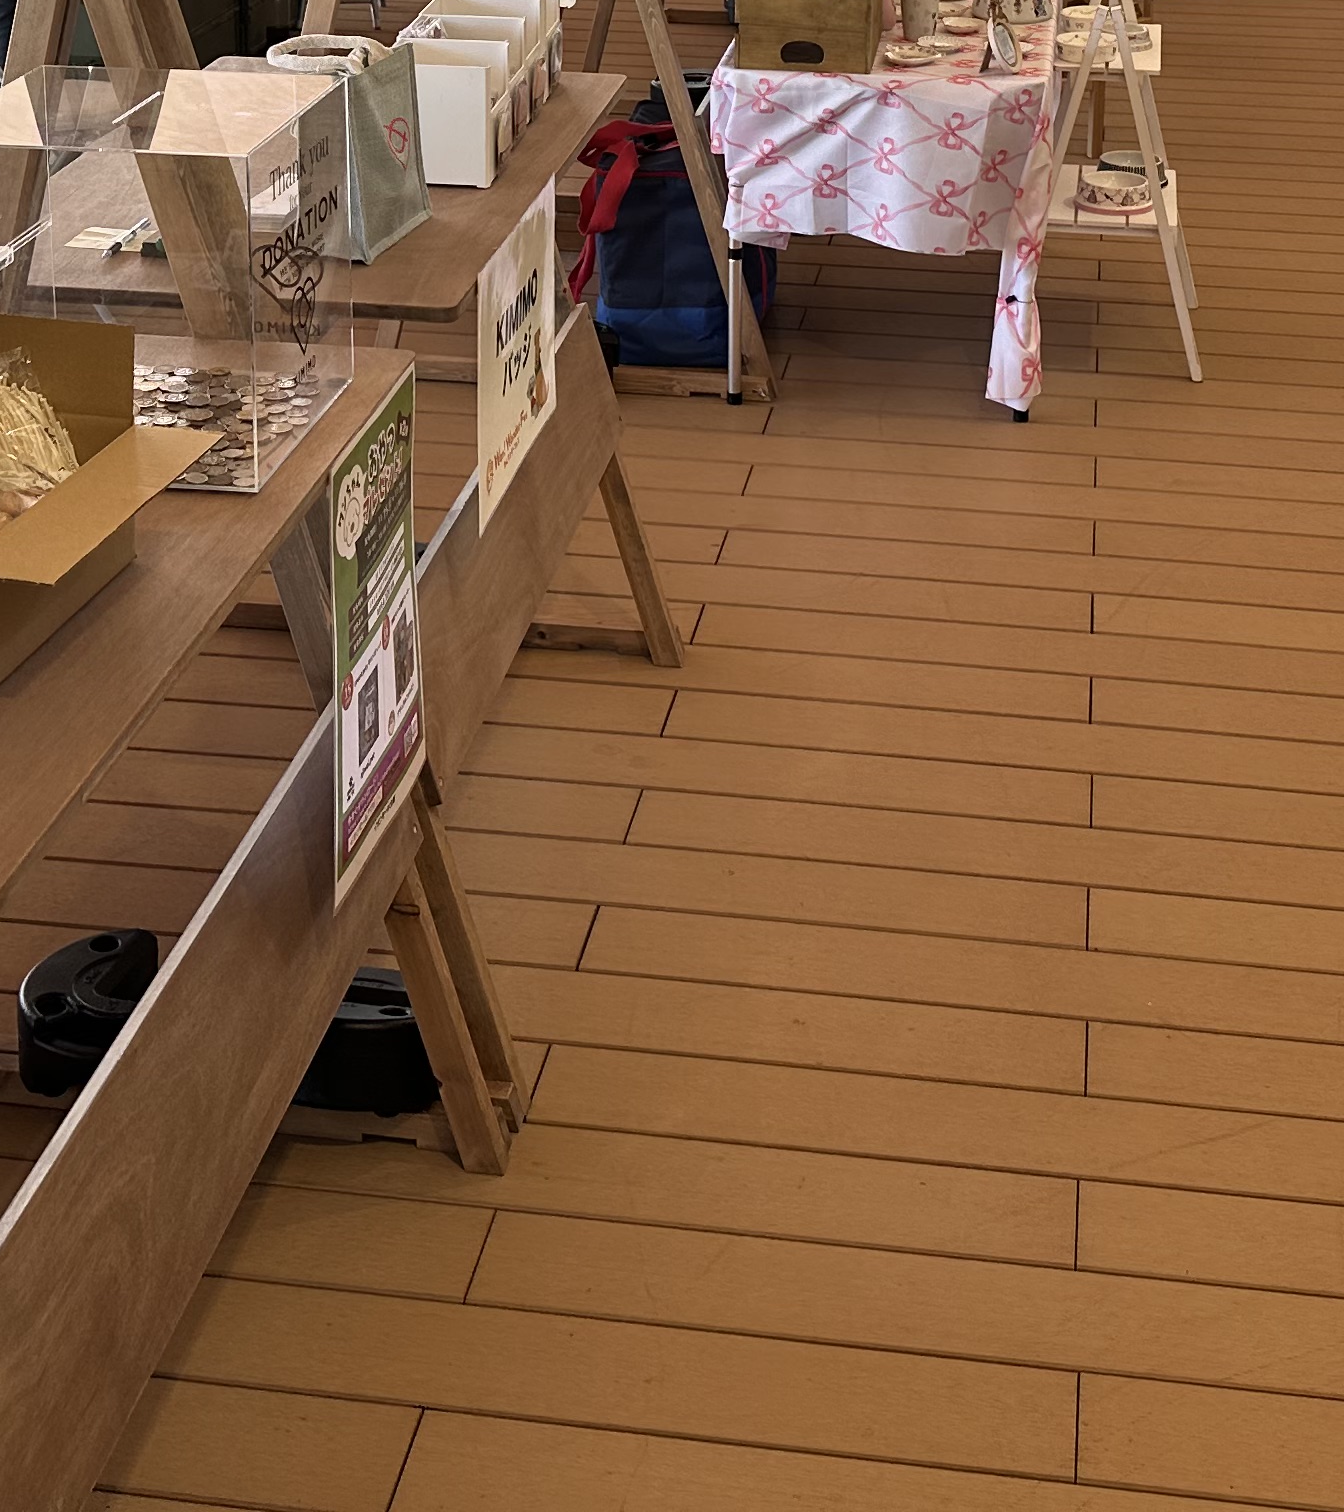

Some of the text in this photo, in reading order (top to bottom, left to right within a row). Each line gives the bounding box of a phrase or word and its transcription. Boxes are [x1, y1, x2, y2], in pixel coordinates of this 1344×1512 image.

[269, 135, 330, 202] Thank you
[262, 185, 339, 272] DONATION
[495, 267, 538, 359] KIMIMO
[502, 322, 532, 397] バッジ
